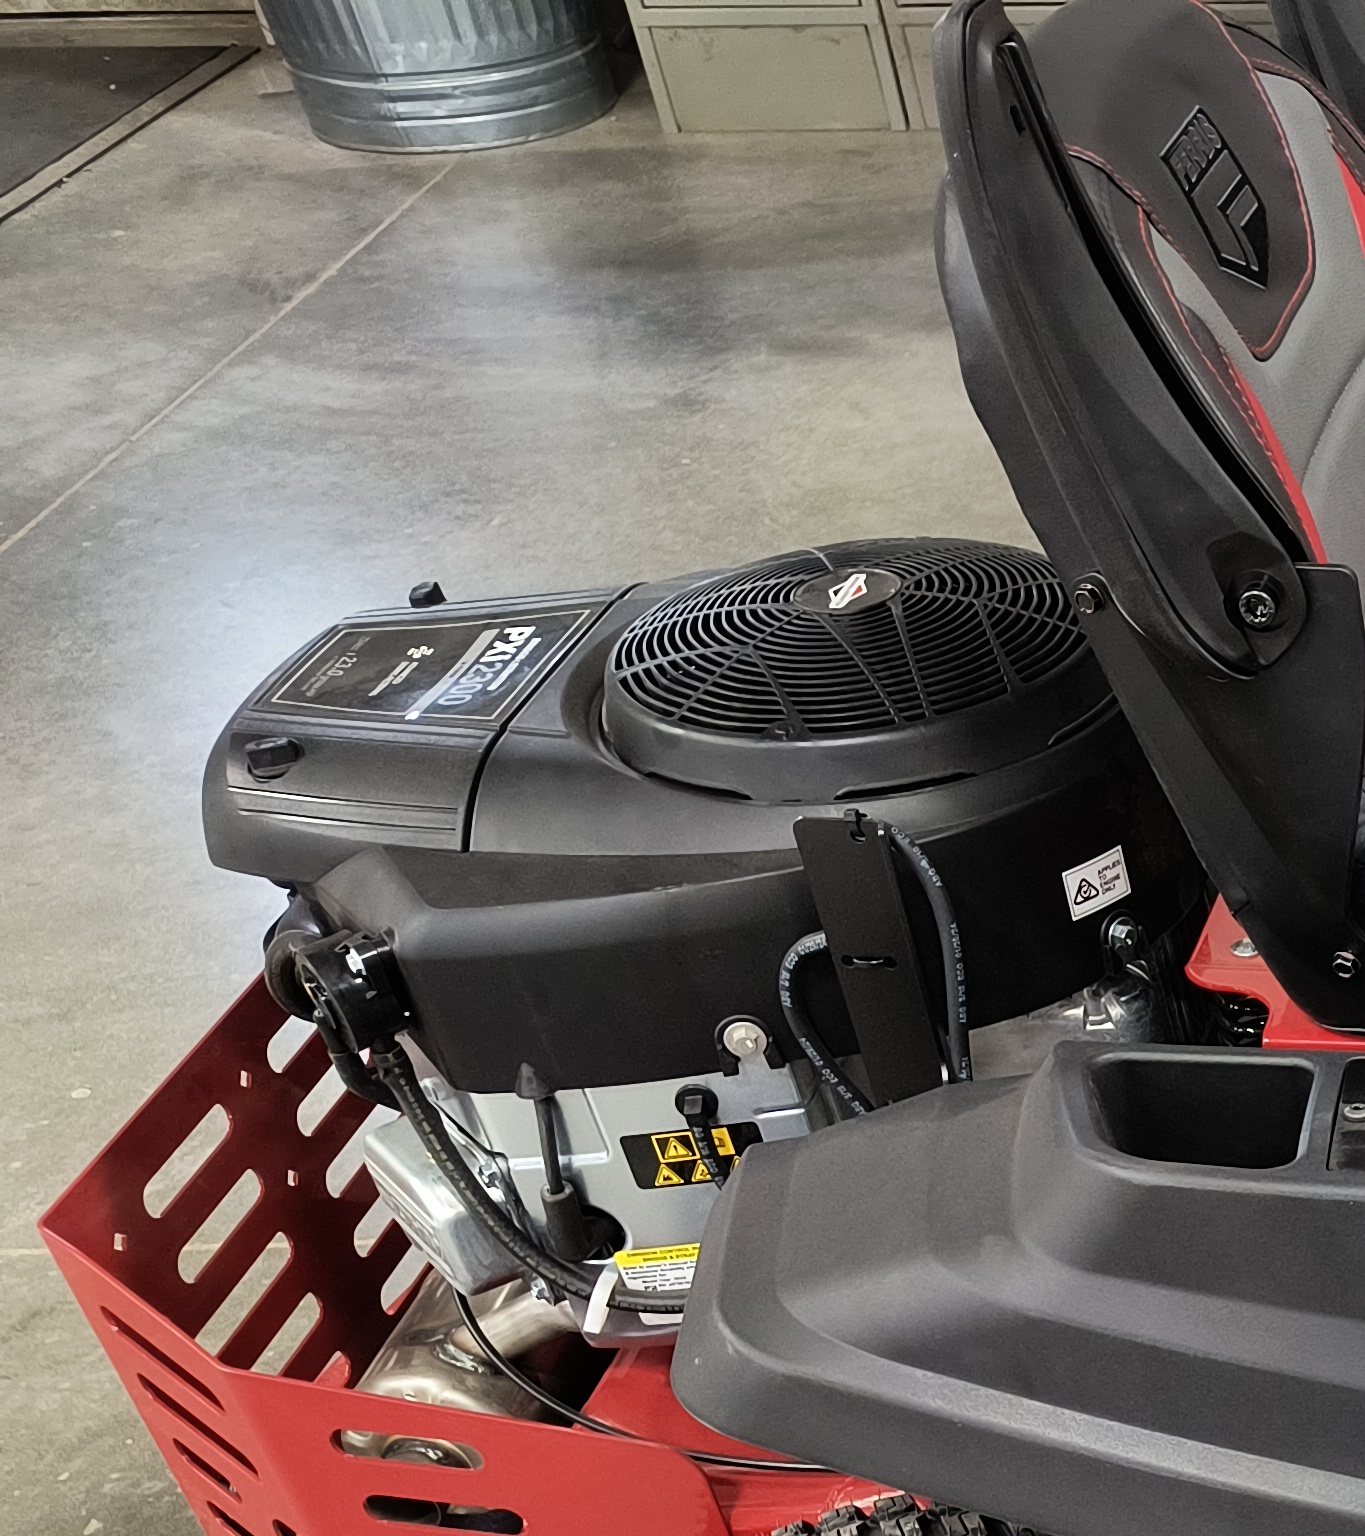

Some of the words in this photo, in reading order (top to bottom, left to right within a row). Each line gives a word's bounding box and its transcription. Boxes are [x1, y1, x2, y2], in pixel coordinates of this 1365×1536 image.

[1174, 112, 1222, 190] FERRIS
[1097, 859, 1121, 875] APPLIES
[1100, 873, 1121, 888] ENGINE
[1102, 884, 1116, 895] ONLY
